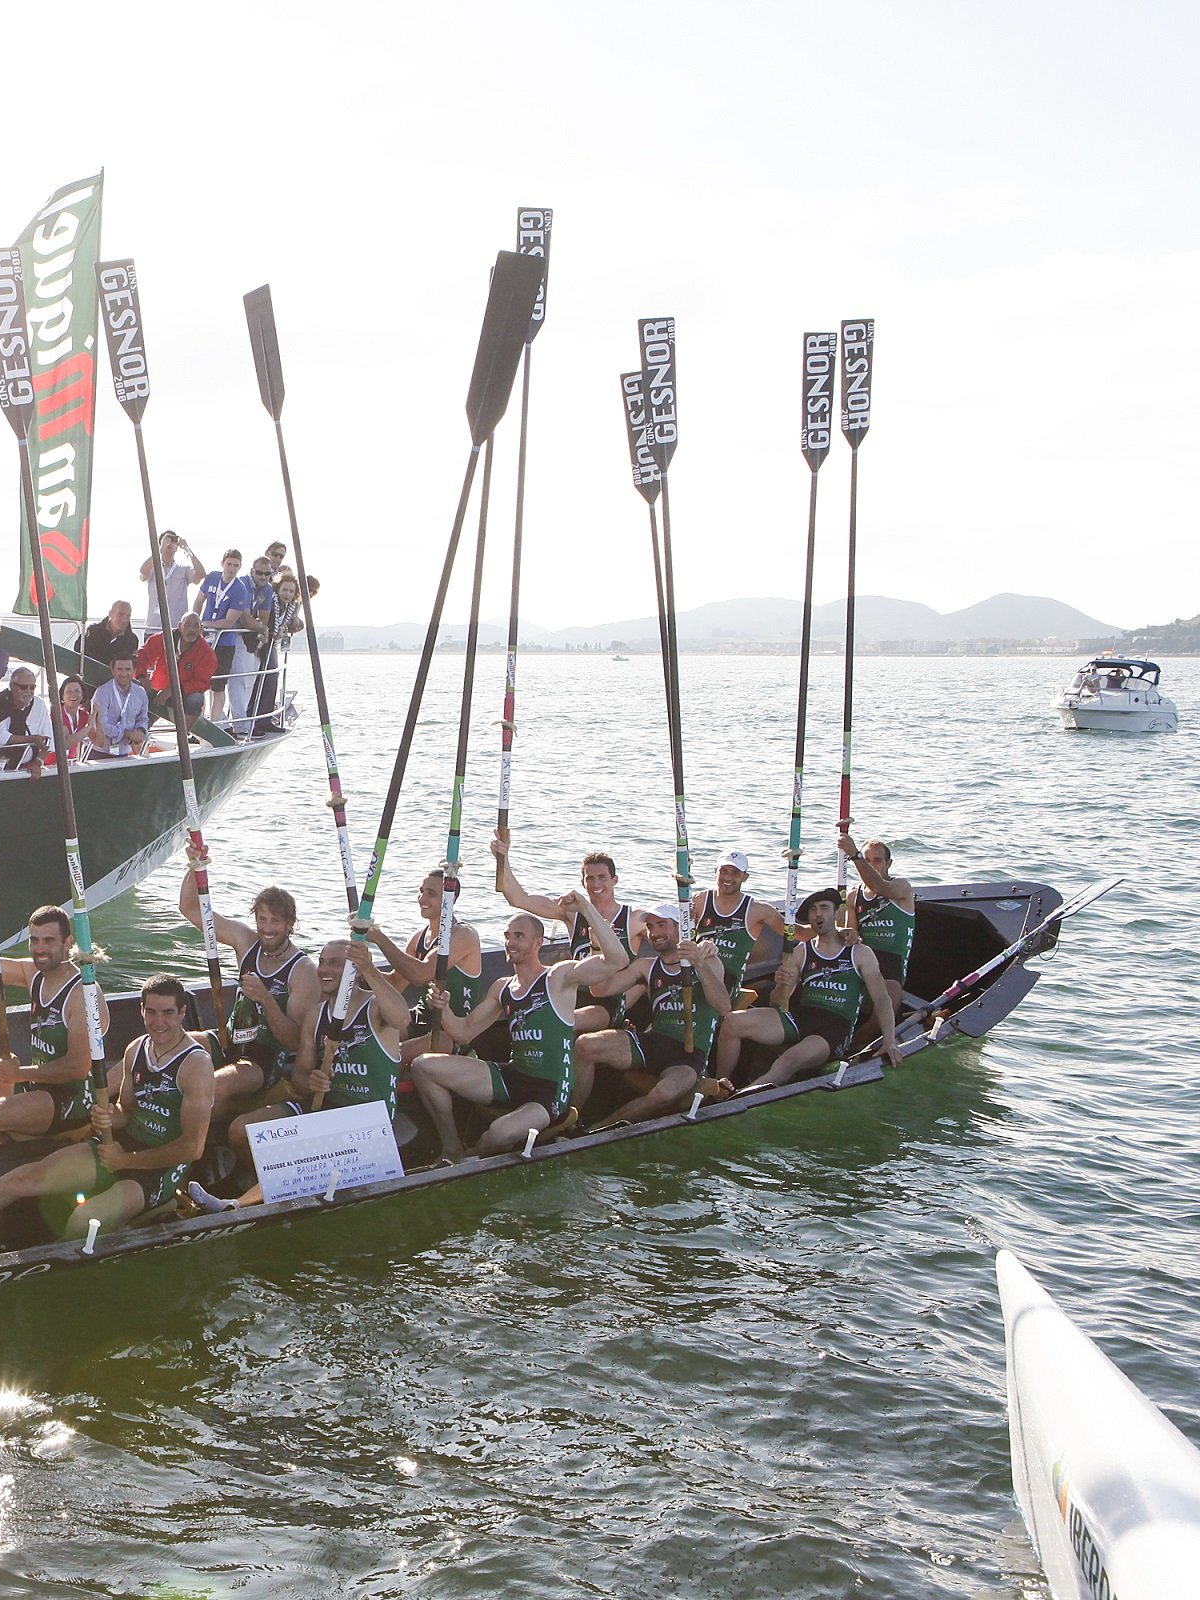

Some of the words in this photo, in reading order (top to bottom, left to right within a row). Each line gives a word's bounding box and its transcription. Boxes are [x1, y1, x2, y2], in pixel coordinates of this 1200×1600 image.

[10, 249, 23, 281] 2000
[100, 267, 149, 401] GESNOR
[644, 320, 678, 444] GESNOR
[844, 323, 870, 430] GESNOR
[114, 375, 126, 402] 2000
[806, 334, 830, 449] GESNOR
[809, 979, 848, 992] KAIKU
